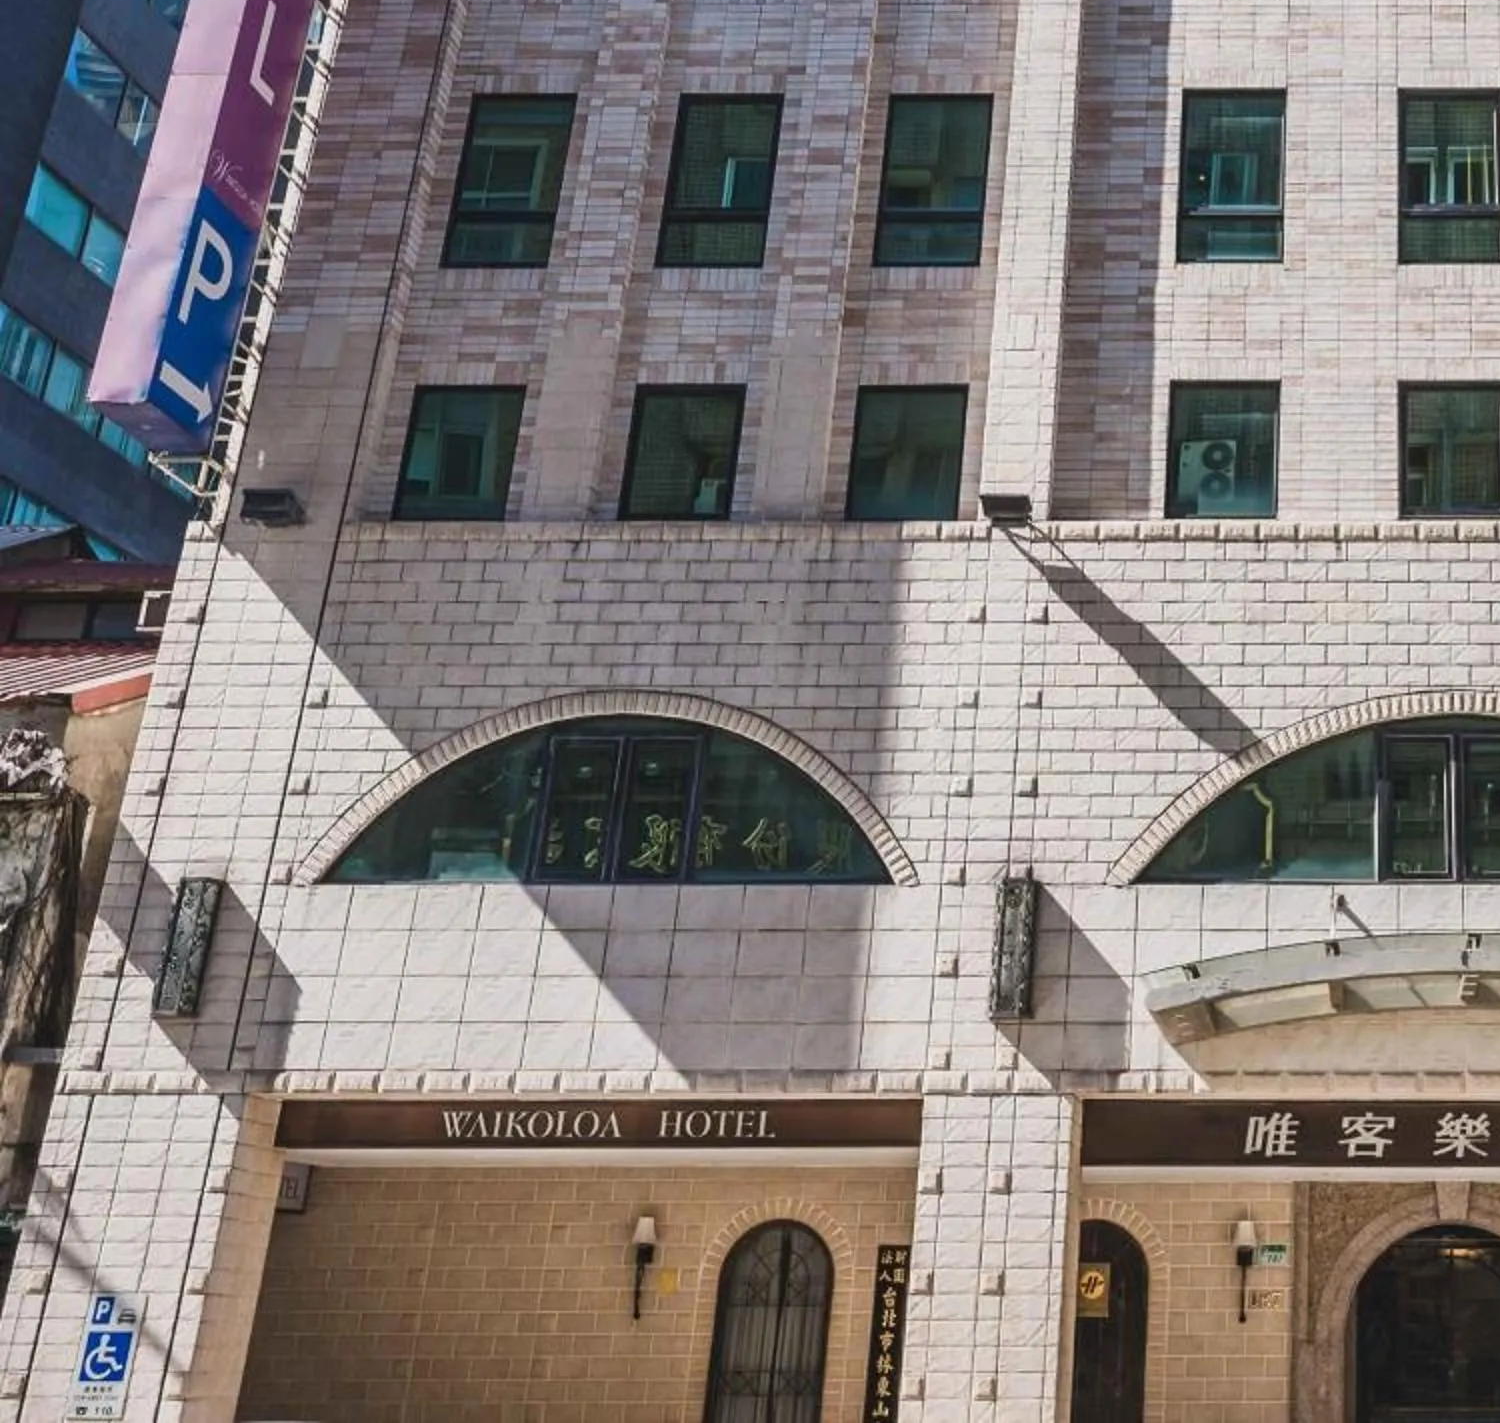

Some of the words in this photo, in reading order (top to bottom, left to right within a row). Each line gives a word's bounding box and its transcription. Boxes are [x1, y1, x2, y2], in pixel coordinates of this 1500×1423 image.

[177, 217, 234, 326] P
[443, 1110, 621, 1139] WAIKOLOA
[659, 1110, 776, 1139] HOTEL
[95, 1300, 111, 1321] P
